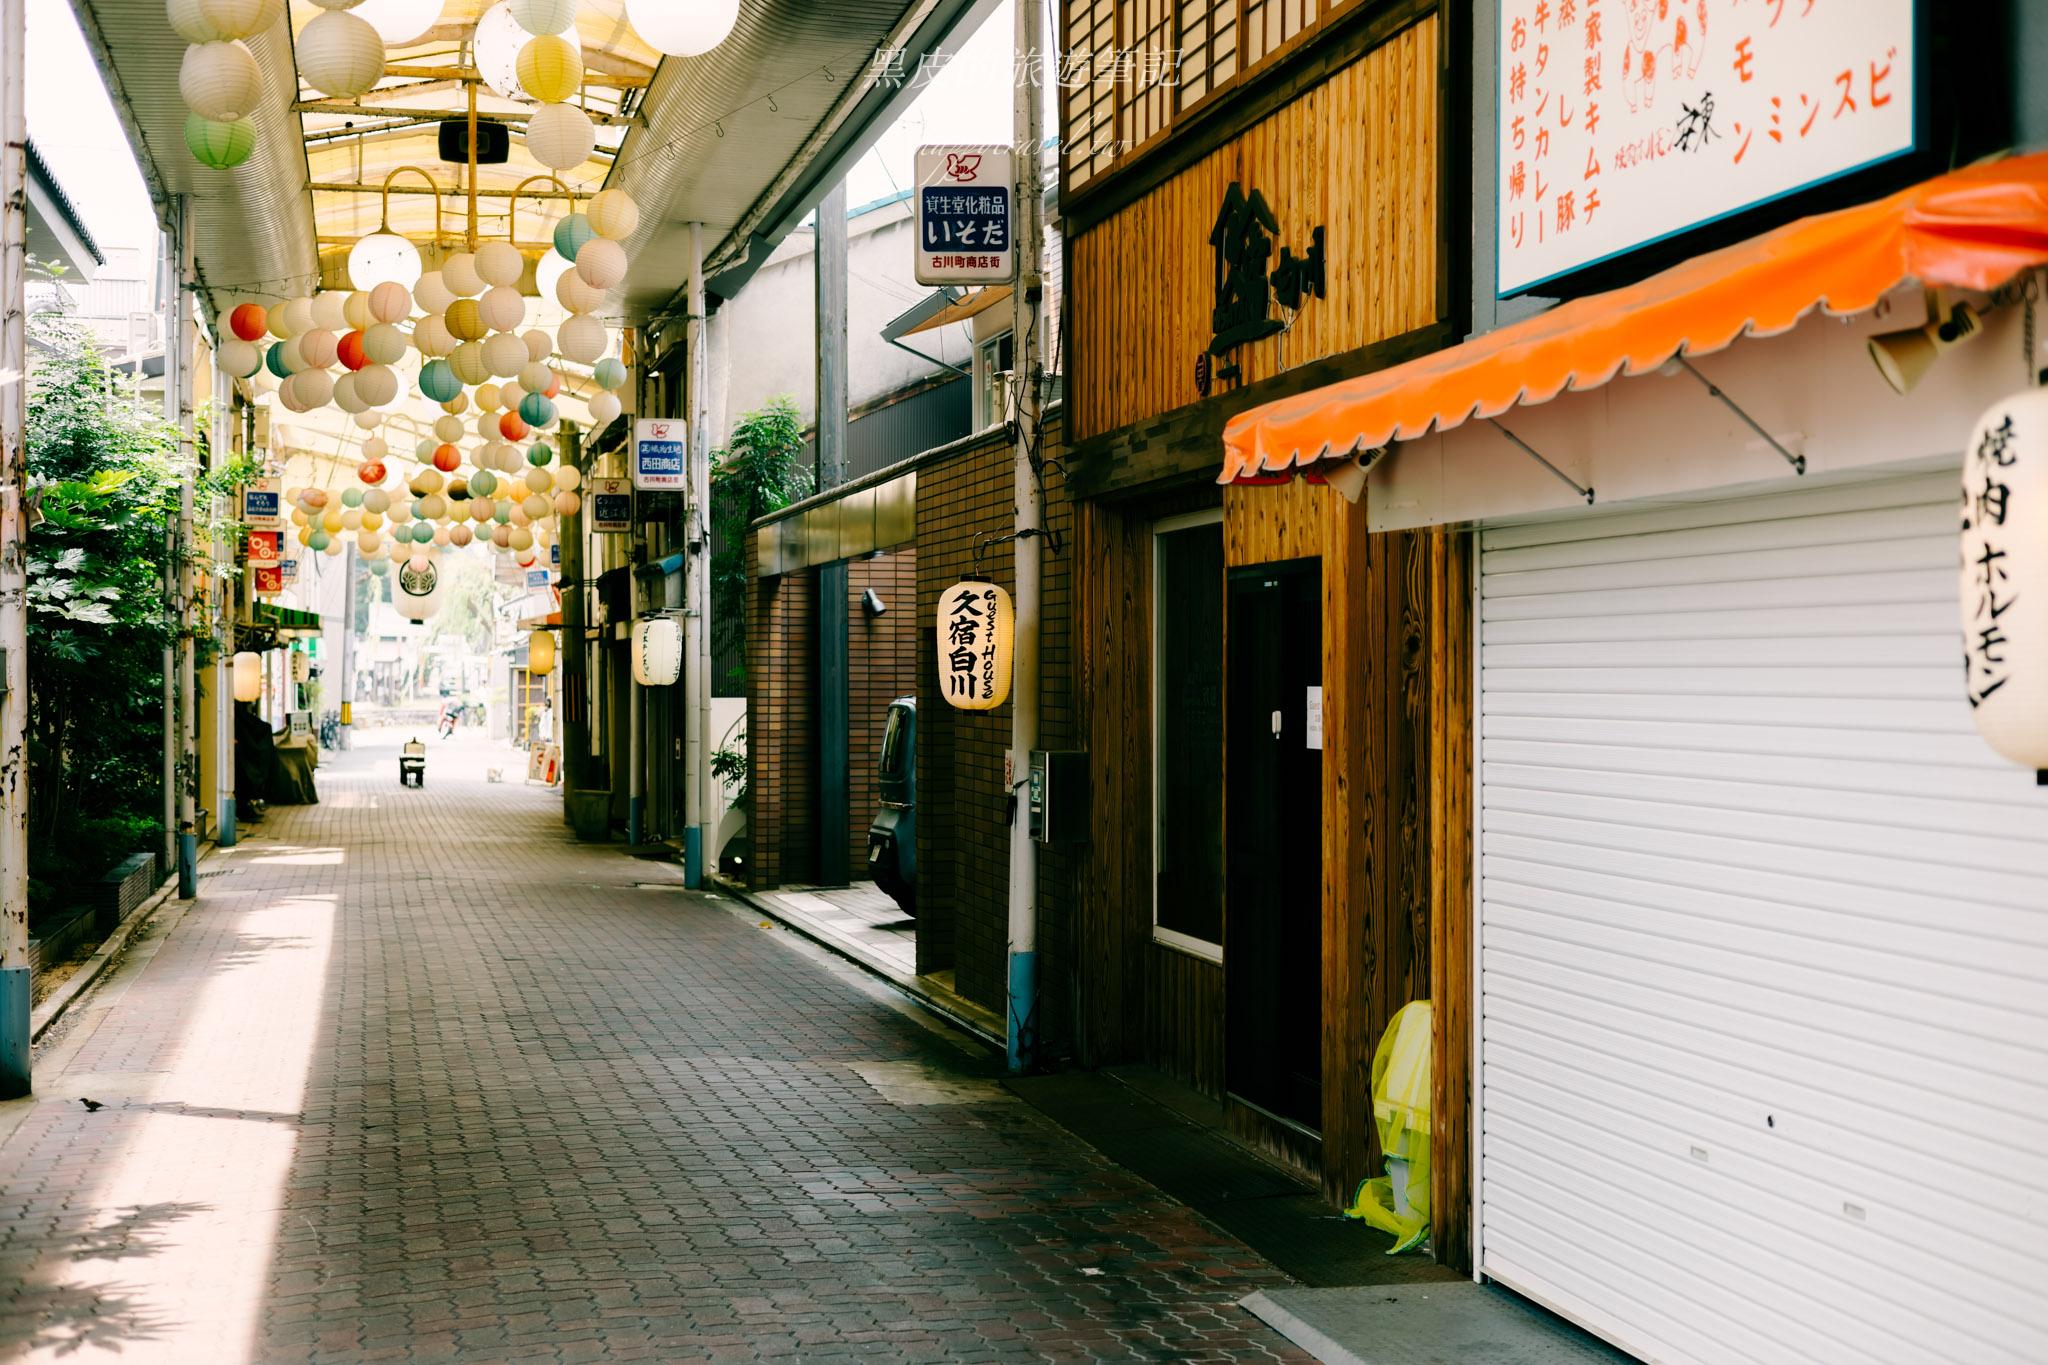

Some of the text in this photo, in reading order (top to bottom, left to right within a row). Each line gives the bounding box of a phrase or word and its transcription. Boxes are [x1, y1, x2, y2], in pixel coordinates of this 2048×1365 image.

[1509, 16, 1527, 248] お持ち帰り
[1582, 0, 1602, 226] 家製キムチ
[926, 195, 1005, 216] 資生堂化粧品
[928, 219, 1004, 245] いそだ
[932, 256, 1001, 269] 古川町商店街
[641, 457, 682, 471] 西田商店
[948, 589, 984, 700] 久宿白川
[981, 589, 997, 700] Guest House
